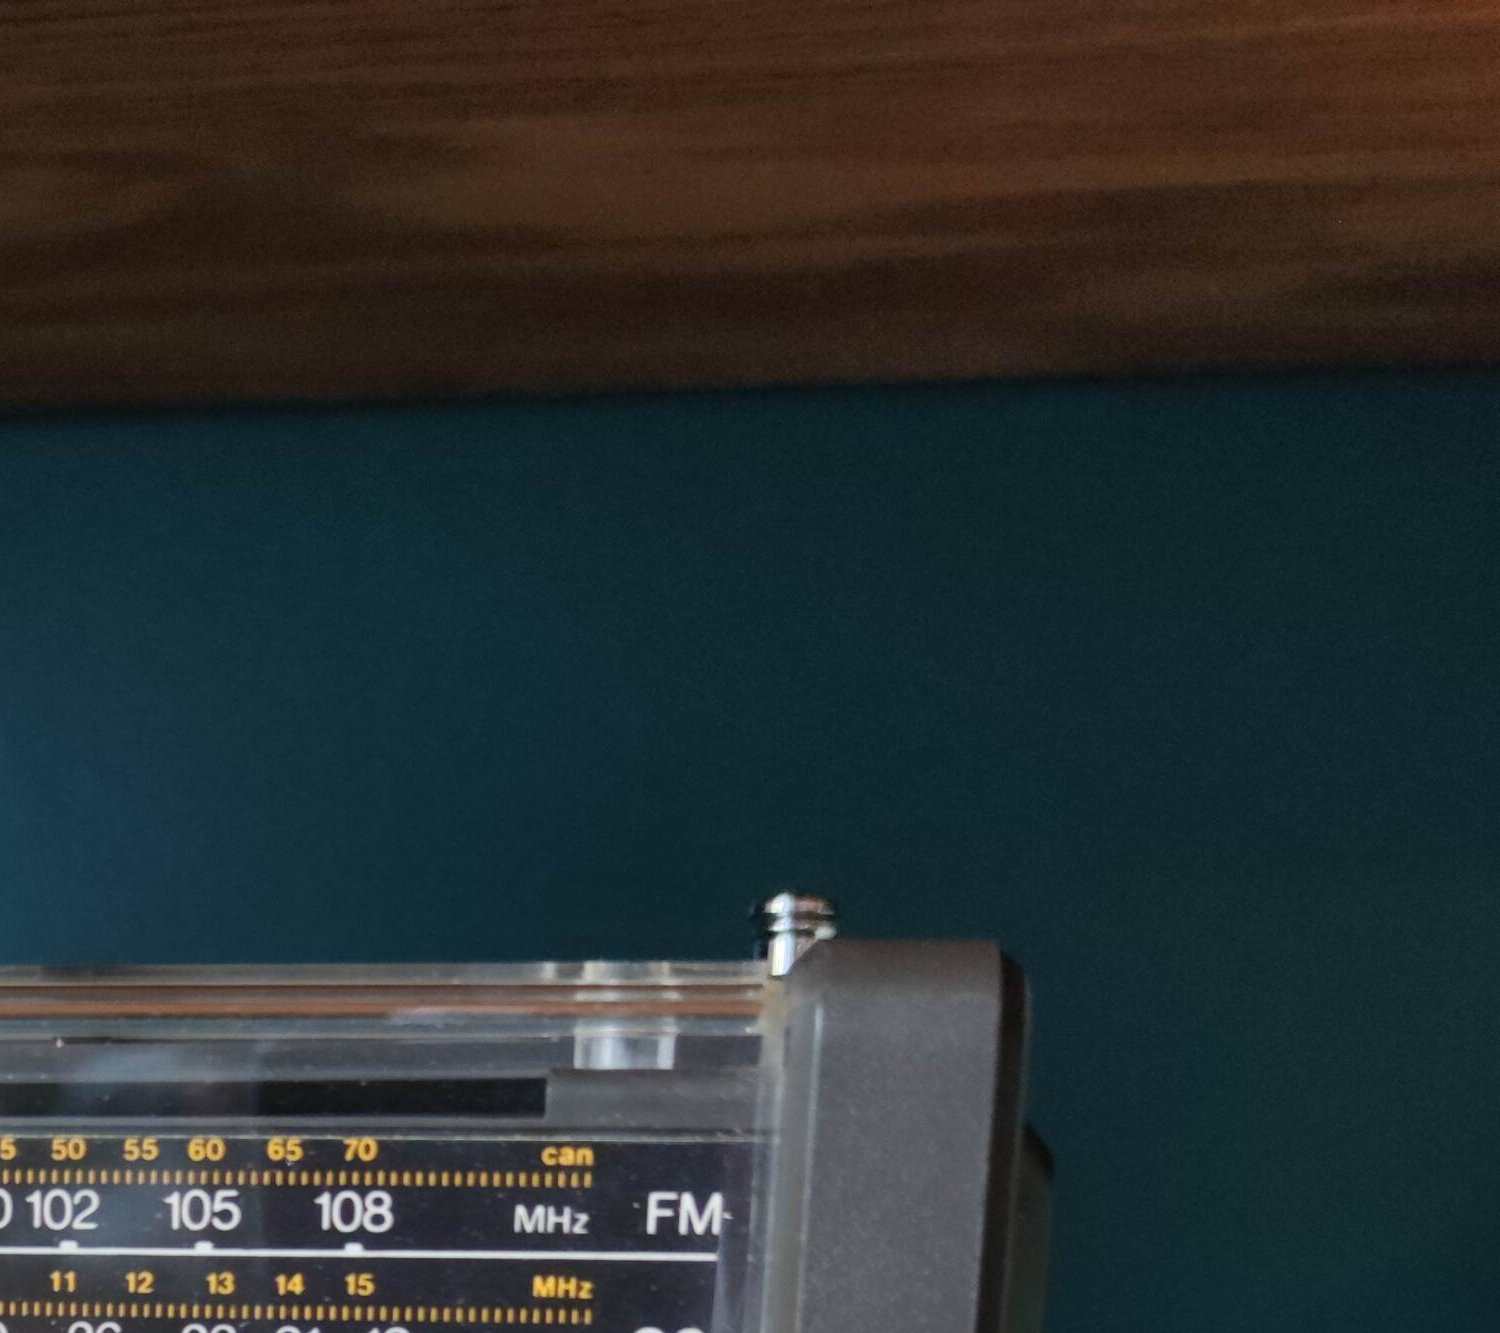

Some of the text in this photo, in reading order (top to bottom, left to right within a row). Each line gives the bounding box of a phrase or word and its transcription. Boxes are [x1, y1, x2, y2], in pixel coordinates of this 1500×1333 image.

[51, 1136, 87, 1161] 50
[122, 1136, 160, 1161] 55
[188, 1138, 227, 1162] 60
[267, 1138, 303, 1162] 65
[343, 1138, 378, 1163] 70
[541, 1146, 595, 1167] can
[25, 1188, 100, 1231] 102
[164, 1190, 242, 1231] 105
[313, 1190, 395, 1232] 108
[513, 1204, 590, 1235] MHz
[645, 1192, 724, 1236] FM
[50, 1270, 76, 1293] 11
[125, 1271, 154, 1294] 12
[206, 1272, 235, 1295] 13
[275, 1272, 304, 1296] 14
[345, 1272, 375, 1296] 15
[532, 1275, 594, 1300] MHz
